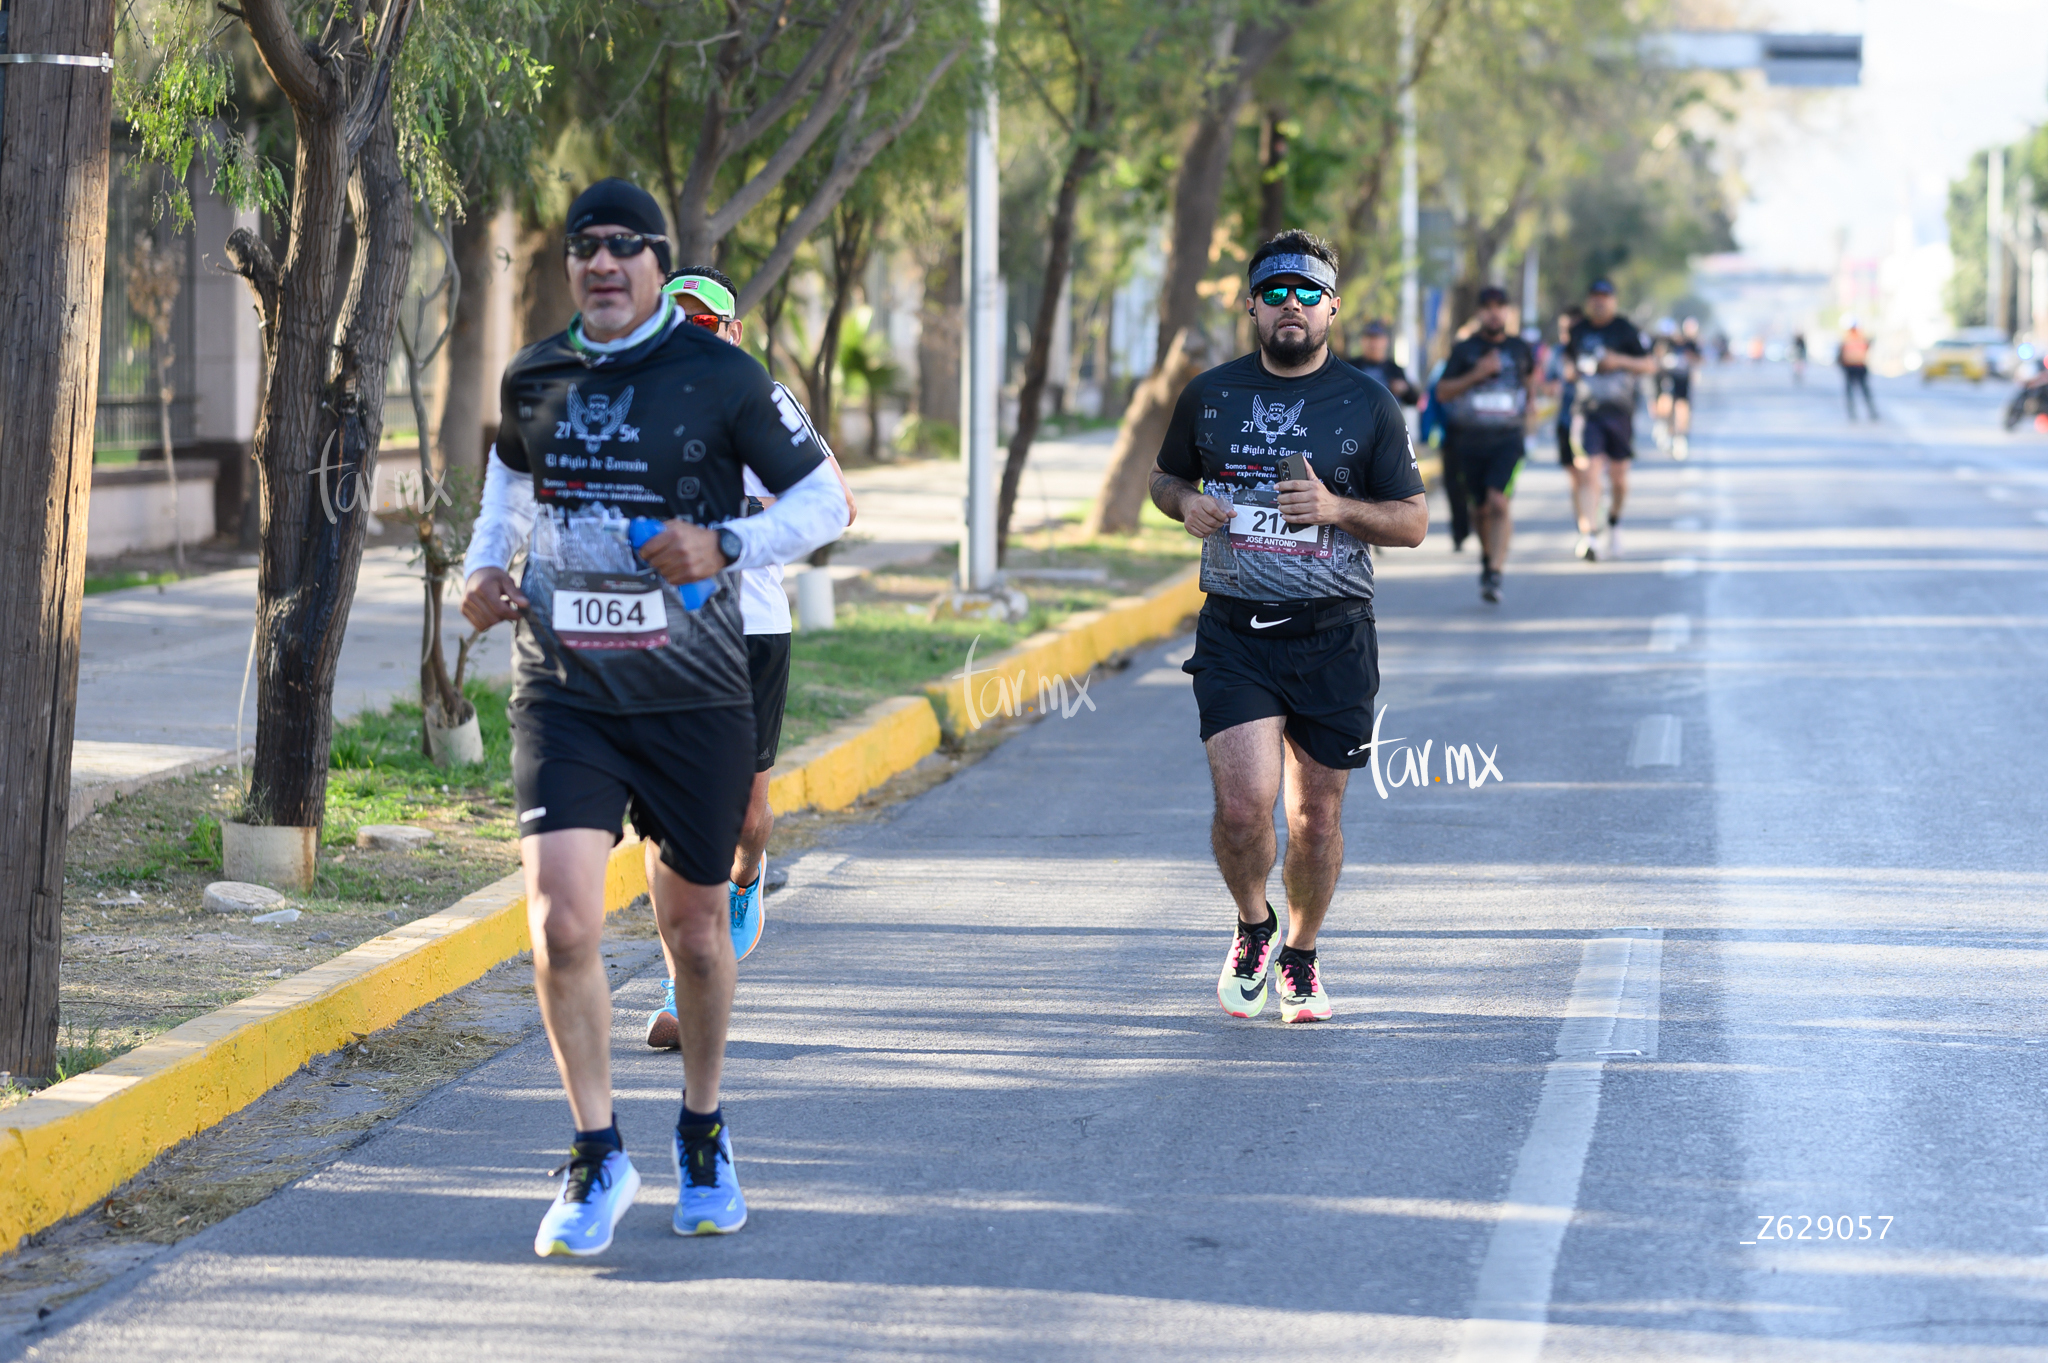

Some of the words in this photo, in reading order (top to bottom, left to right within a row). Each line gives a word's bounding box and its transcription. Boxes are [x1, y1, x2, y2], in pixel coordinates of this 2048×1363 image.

[554, 420, 571, 439] 21
[1240, 421, 1254, 433] 21
[1291, 424, 1307, 437] 5K
[1230, 444, 1240, 454] El
[1241, 444, 1264, 457] Siglo
[1267, 446, 1277, 456] de
[1279, 446, 1312, 459] Torón
[1224, 462, 1247, 471] Somos
[1245, 535, 1263, 545] JOSÉ
[1264, 537, 1297, 549] ANTONIO
[1319, 549, 1329, 557] 217
[572, 598, 646, 627] 1064
